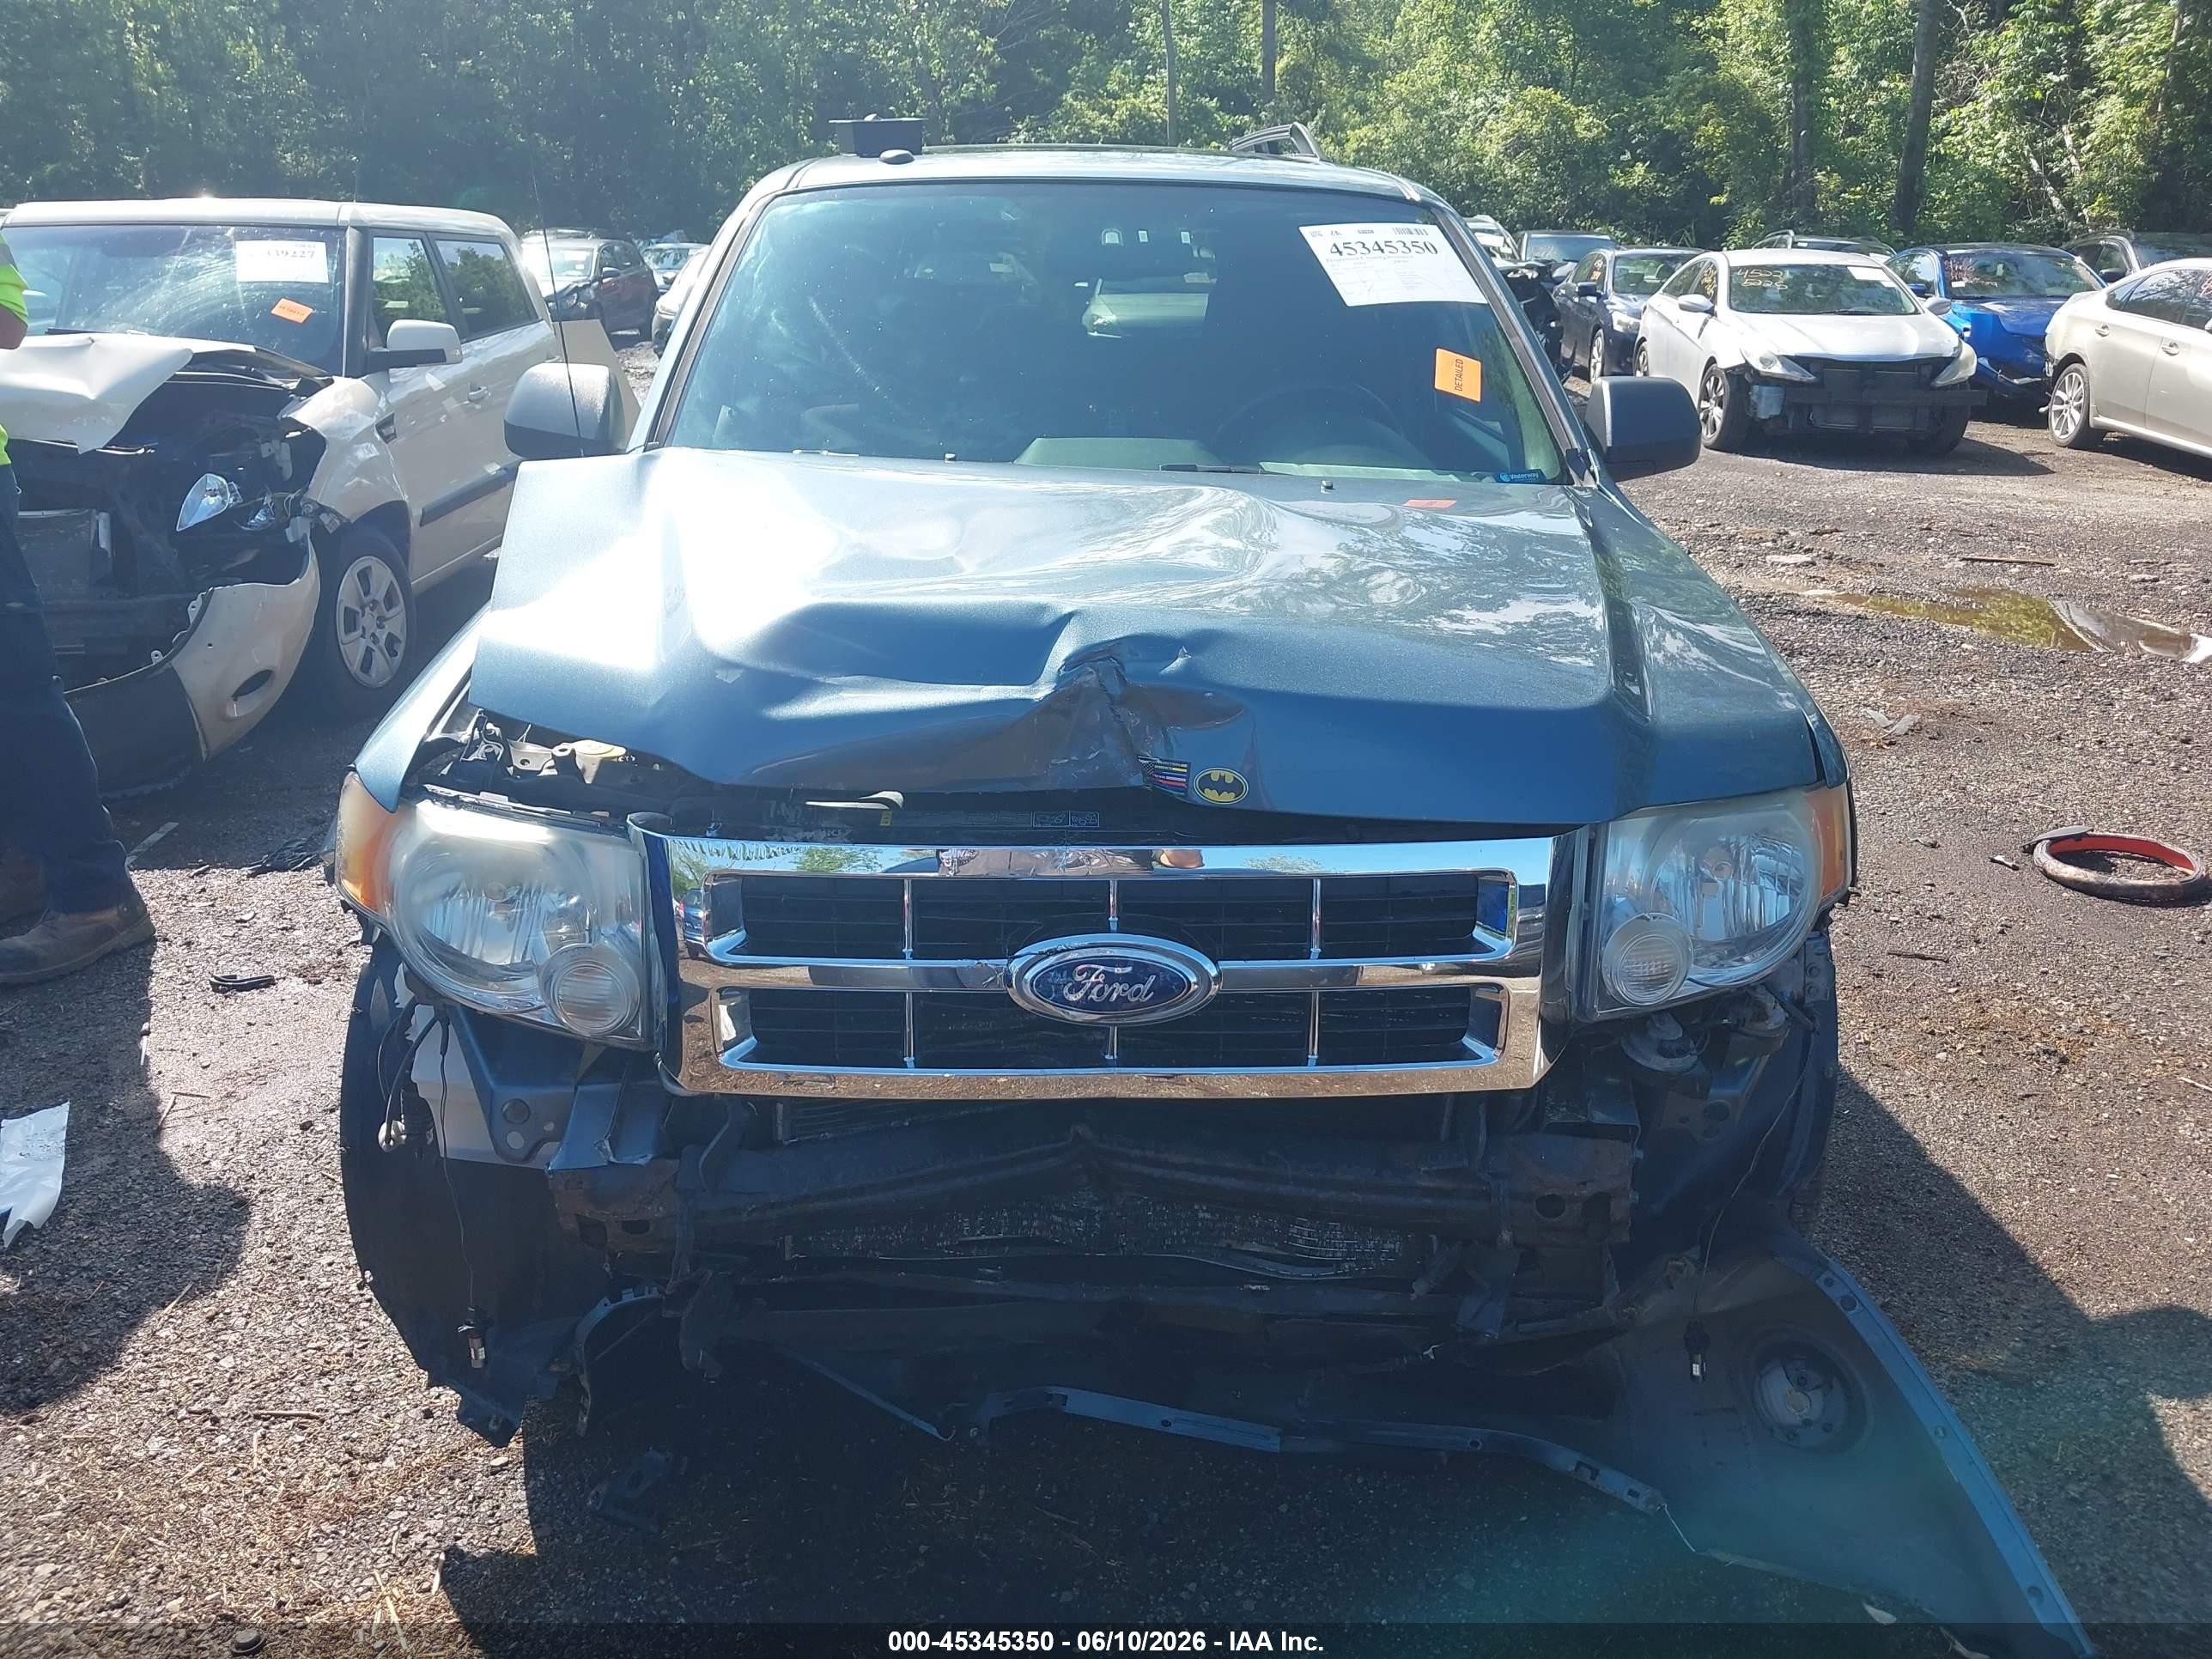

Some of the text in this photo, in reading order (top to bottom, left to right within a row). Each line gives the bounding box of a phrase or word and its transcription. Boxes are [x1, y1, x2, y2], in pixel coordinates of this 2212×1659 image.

[1330, 240, 1438, 256] 45345350
[1455, 358, 1464, 392] DETAILED
[1062, 963, 1157, 1002] Ford
